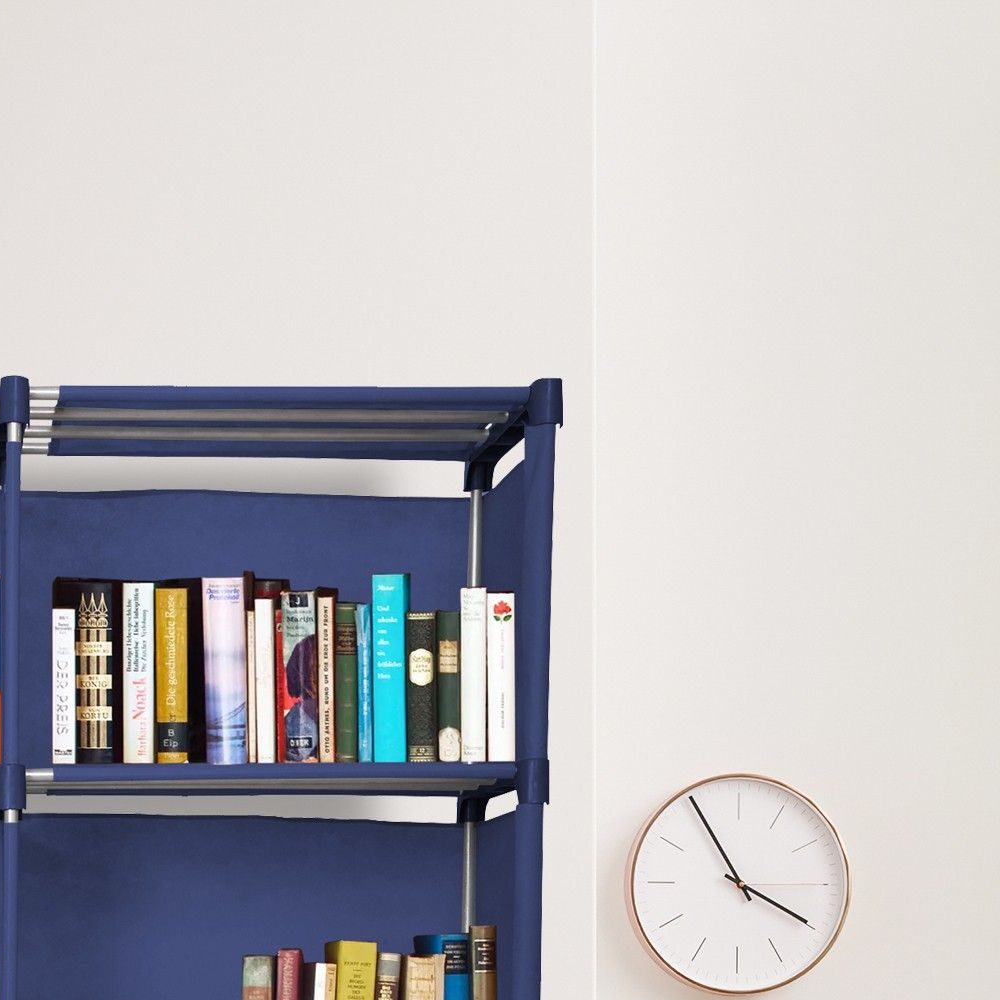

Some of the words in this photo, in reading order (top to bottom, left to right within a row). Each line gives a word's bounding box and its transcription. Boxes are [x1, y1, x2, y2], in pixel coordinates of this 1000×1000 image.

[165, 595, 175, 618] Rose
[166, 620, 177, 686] geschmiedete
[324, 674, 329, 684] UM
[132, 676, 147, 720] Noack
[166, 689, 176, 706] Die
[168, 728, 175, 737] B
